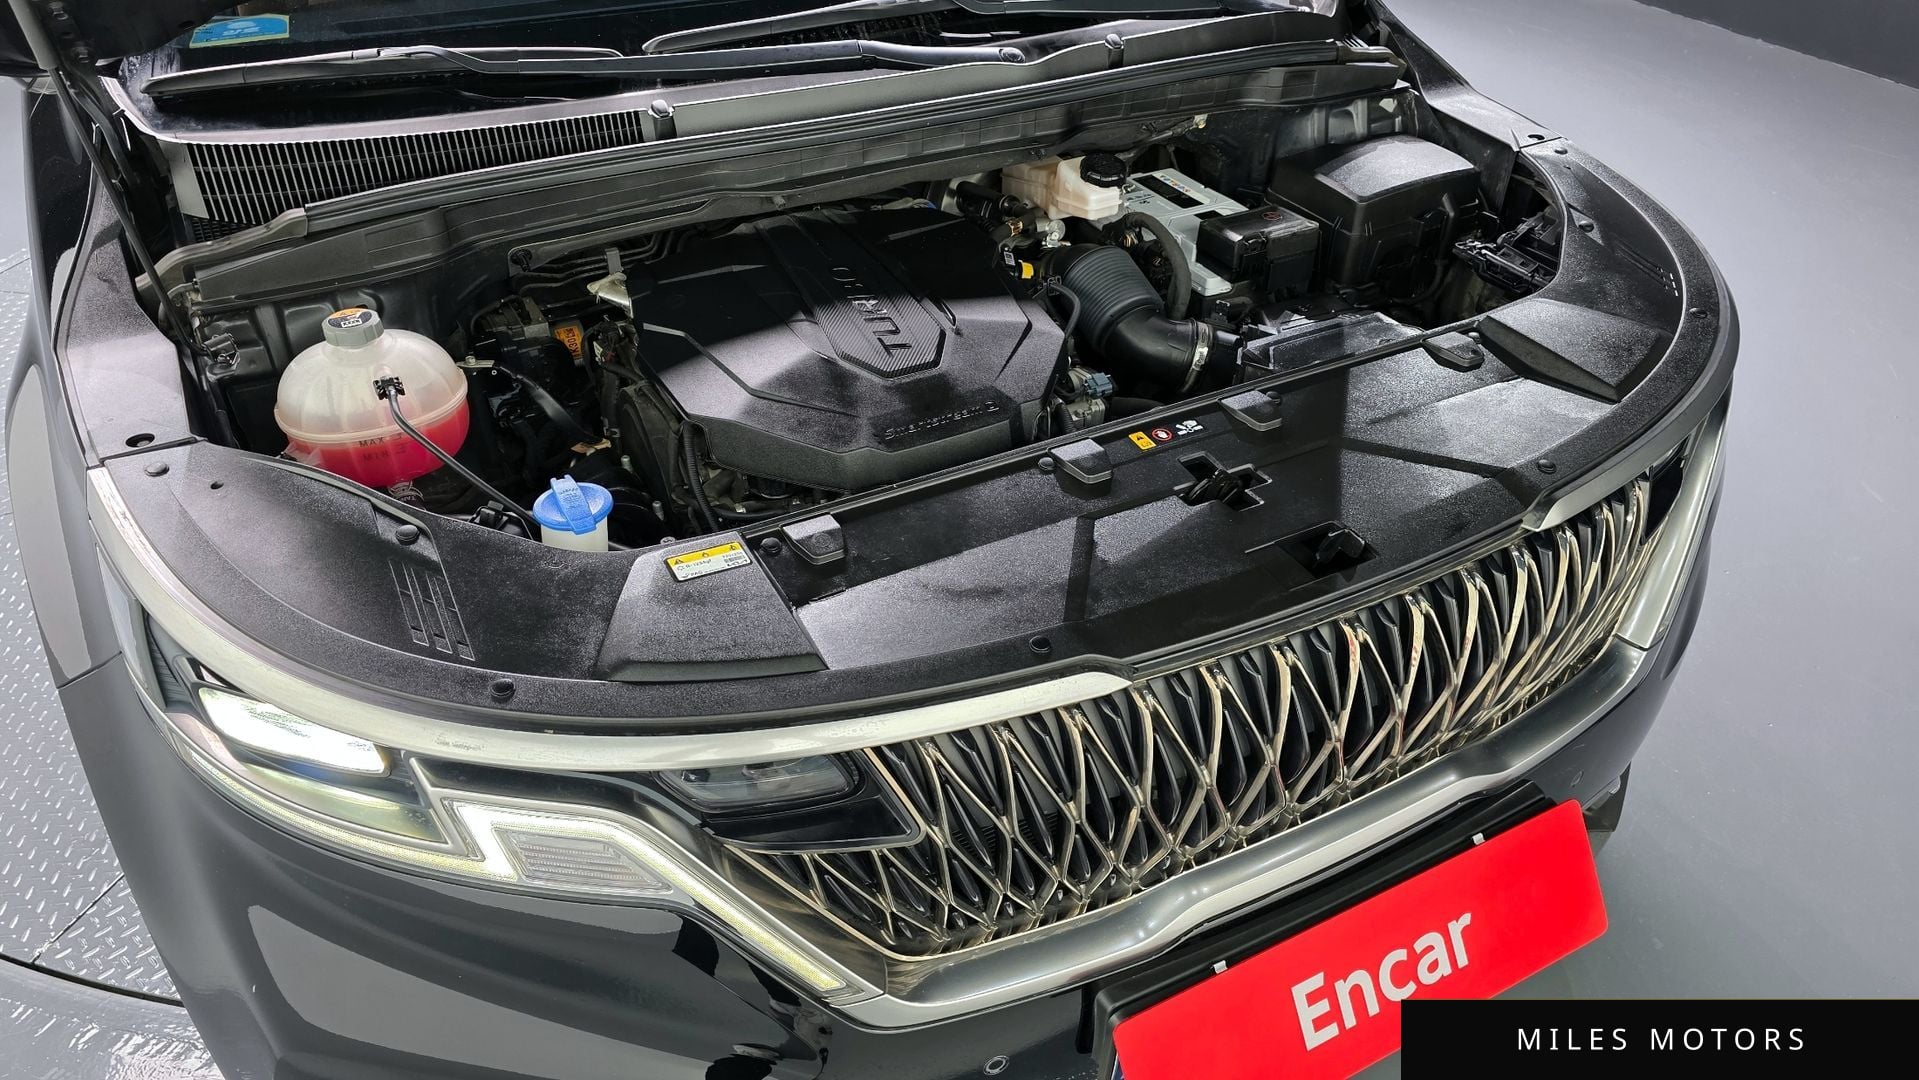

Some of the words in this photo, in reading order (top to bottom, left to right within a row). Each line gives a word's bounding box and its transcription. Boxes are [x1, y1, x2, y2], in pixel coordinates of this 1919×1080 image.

[359, 436, 384, 447] MAX
[363, 449, 389, 459] MIN
[1291, 912, 1473, 1051] Encar
